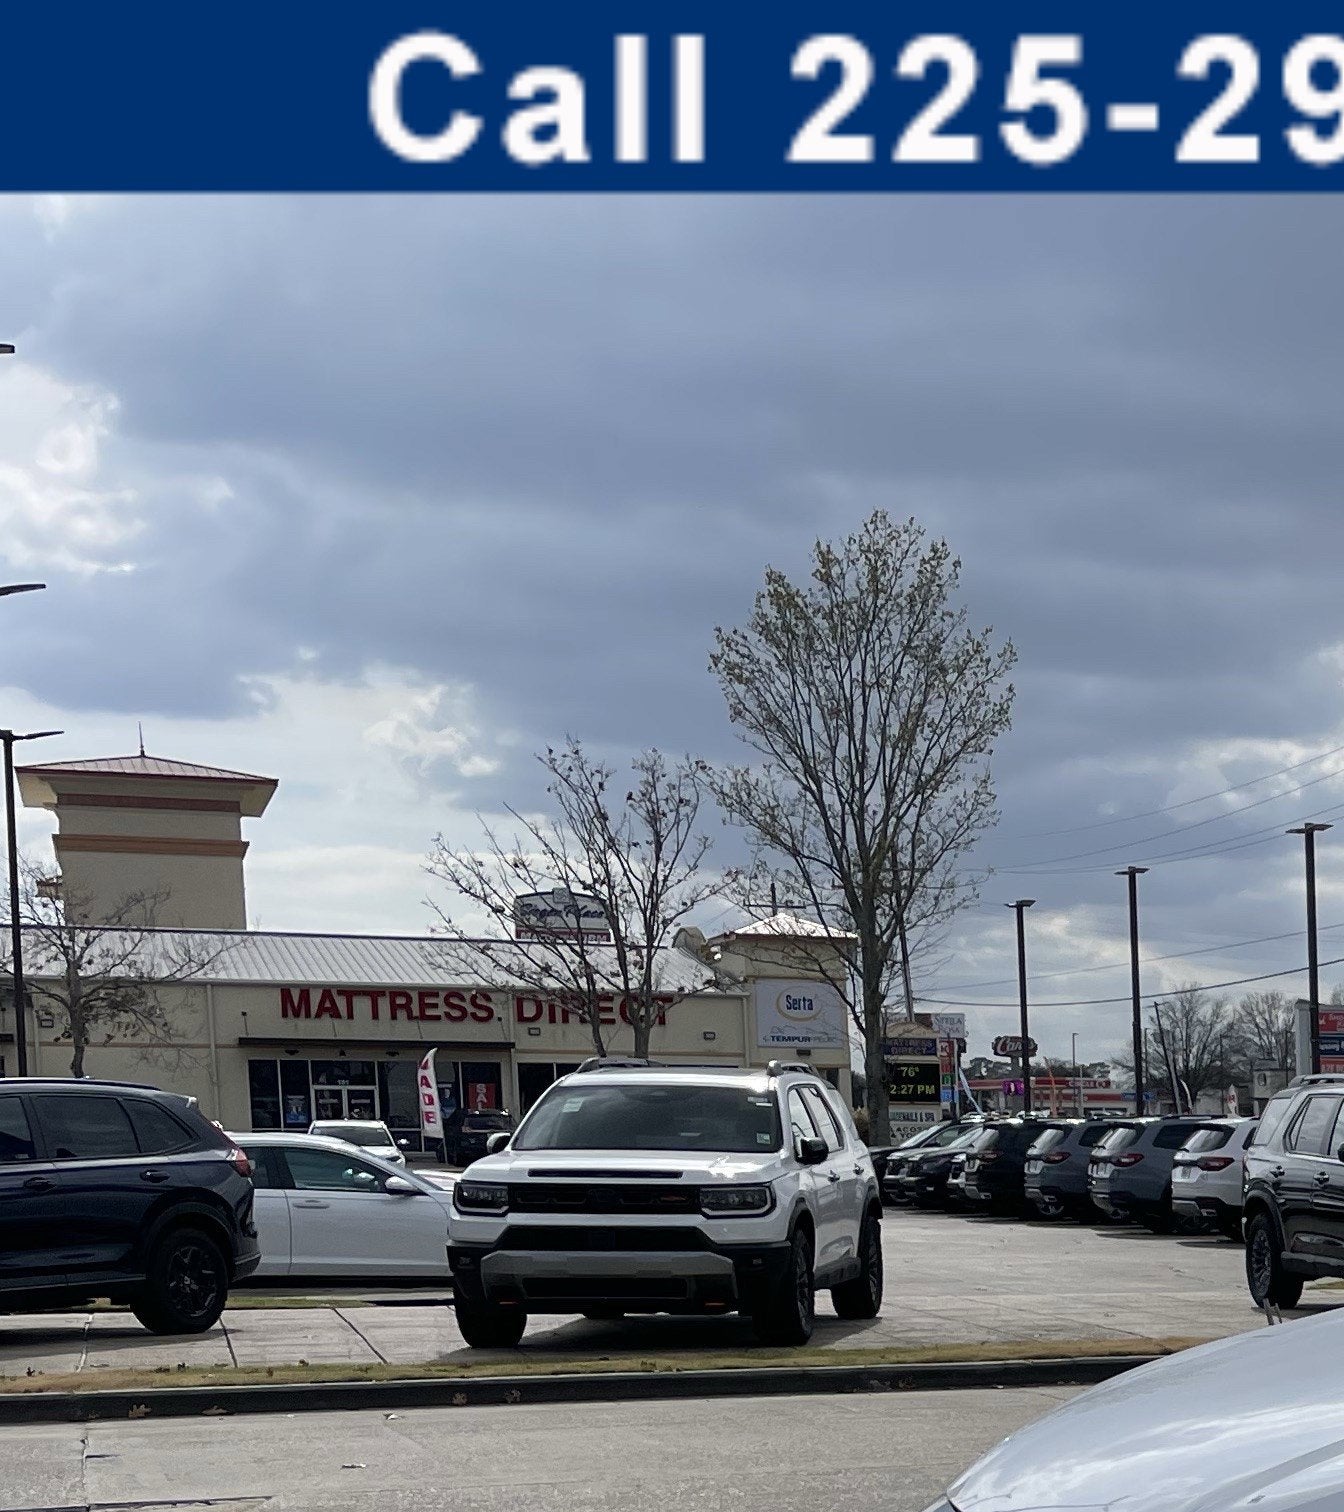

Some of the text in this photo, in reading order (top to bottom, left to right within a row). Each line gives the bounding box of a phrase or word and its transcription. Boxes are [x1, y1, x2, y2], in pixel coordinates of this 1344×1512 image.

[280, 987, 675, 1026] MATTRESS DIRECT
[785, 994, 814, 1011] Serta
